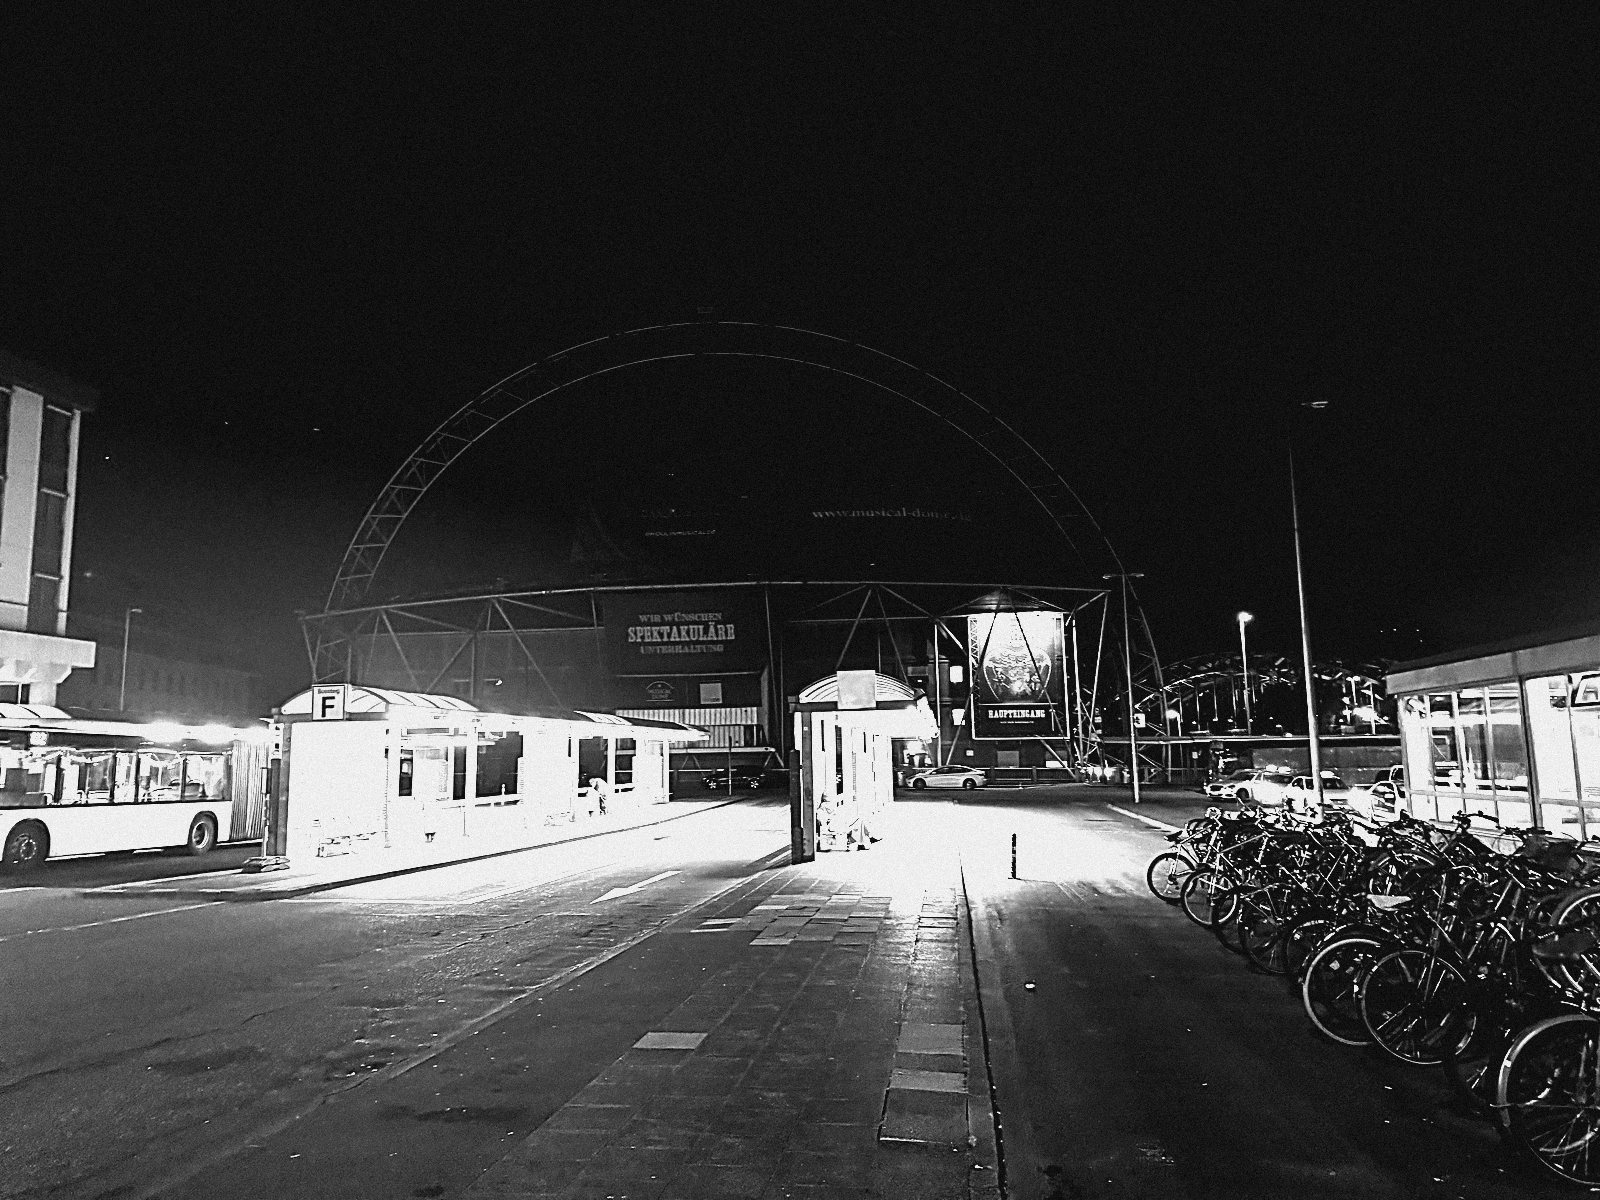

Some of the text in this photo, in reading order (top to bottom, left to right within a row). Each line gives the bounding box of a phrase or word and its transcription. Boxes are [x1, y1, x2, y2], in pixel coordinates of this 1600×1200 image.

[639, 612, 722, 623] WIR WÜNSCHEN
[628, 622, 735, 643] SPEKTAKULÄRE
[640, 644, 724, 654] UNTERHALTUNG
[321, 696, 335, 718] F
[988, 709, 1046, 719] HAUPTEINGANG
